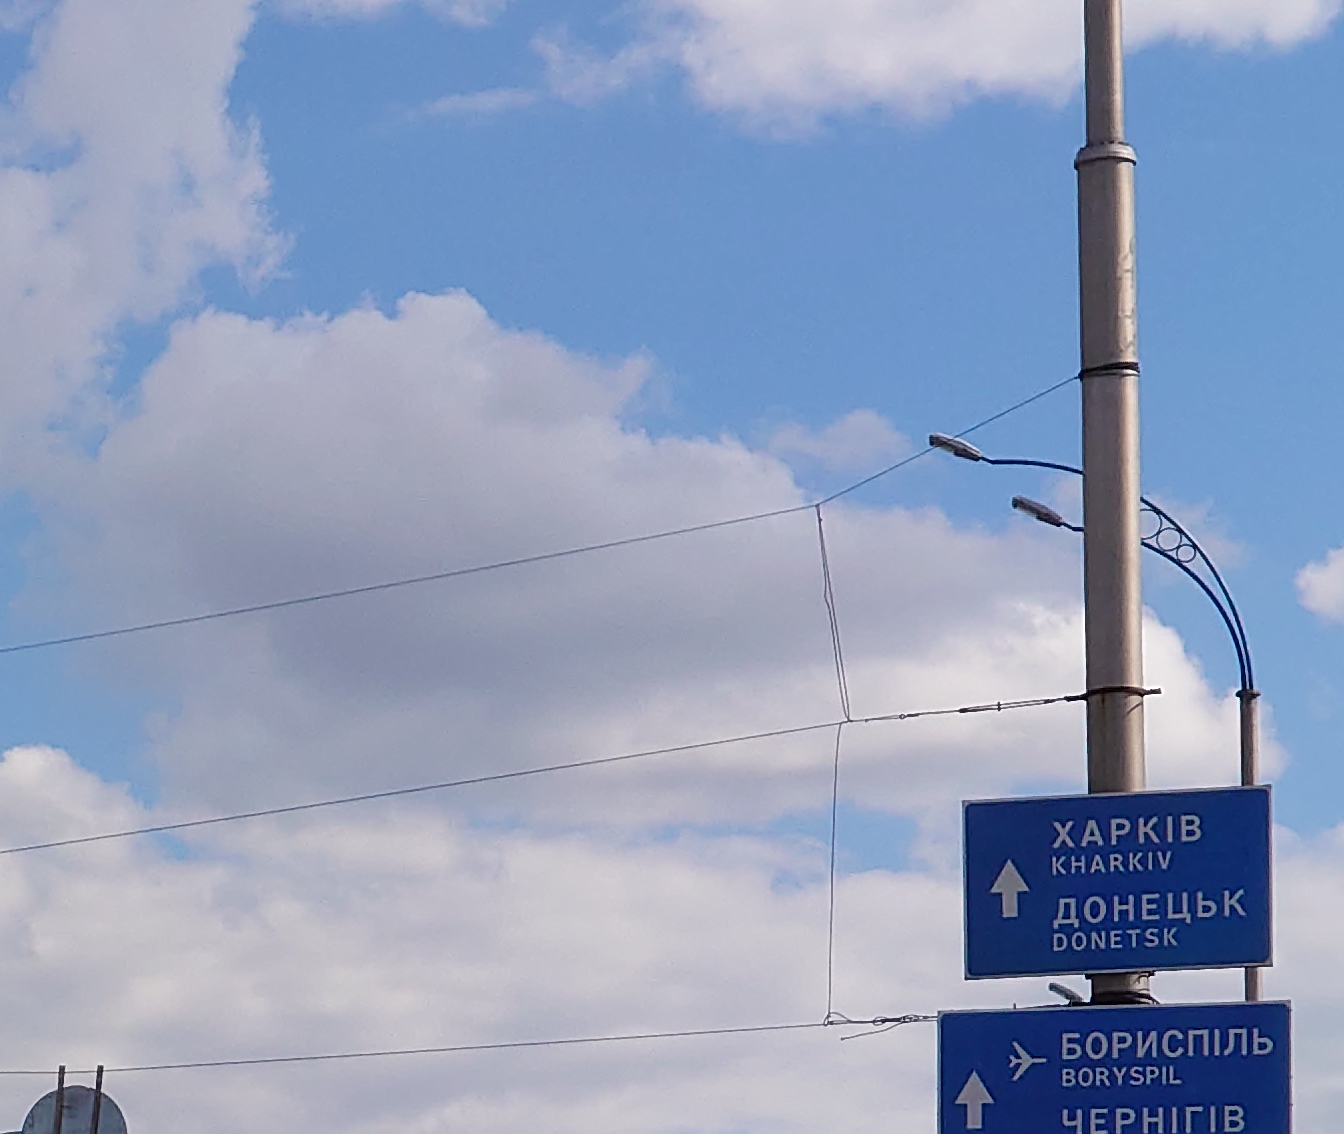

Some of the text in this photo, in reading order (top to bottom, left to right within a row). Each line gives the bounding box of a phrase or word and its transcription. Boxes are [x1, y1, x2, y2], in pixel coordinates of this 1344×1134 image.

[1052, 814, 1202, 848] ХАРКІВ
[1051, 851, 1172, 876] KHARKIV
[1053, 889, 1247, 929] ДОНЕЦЬК
[1053, 928, 1179, 952] DONETSK
[1061, 1028, 1274, 1061] БОРИСПІЛЬ
[1061, 1066, 1182, 1087] BORYSPIL
